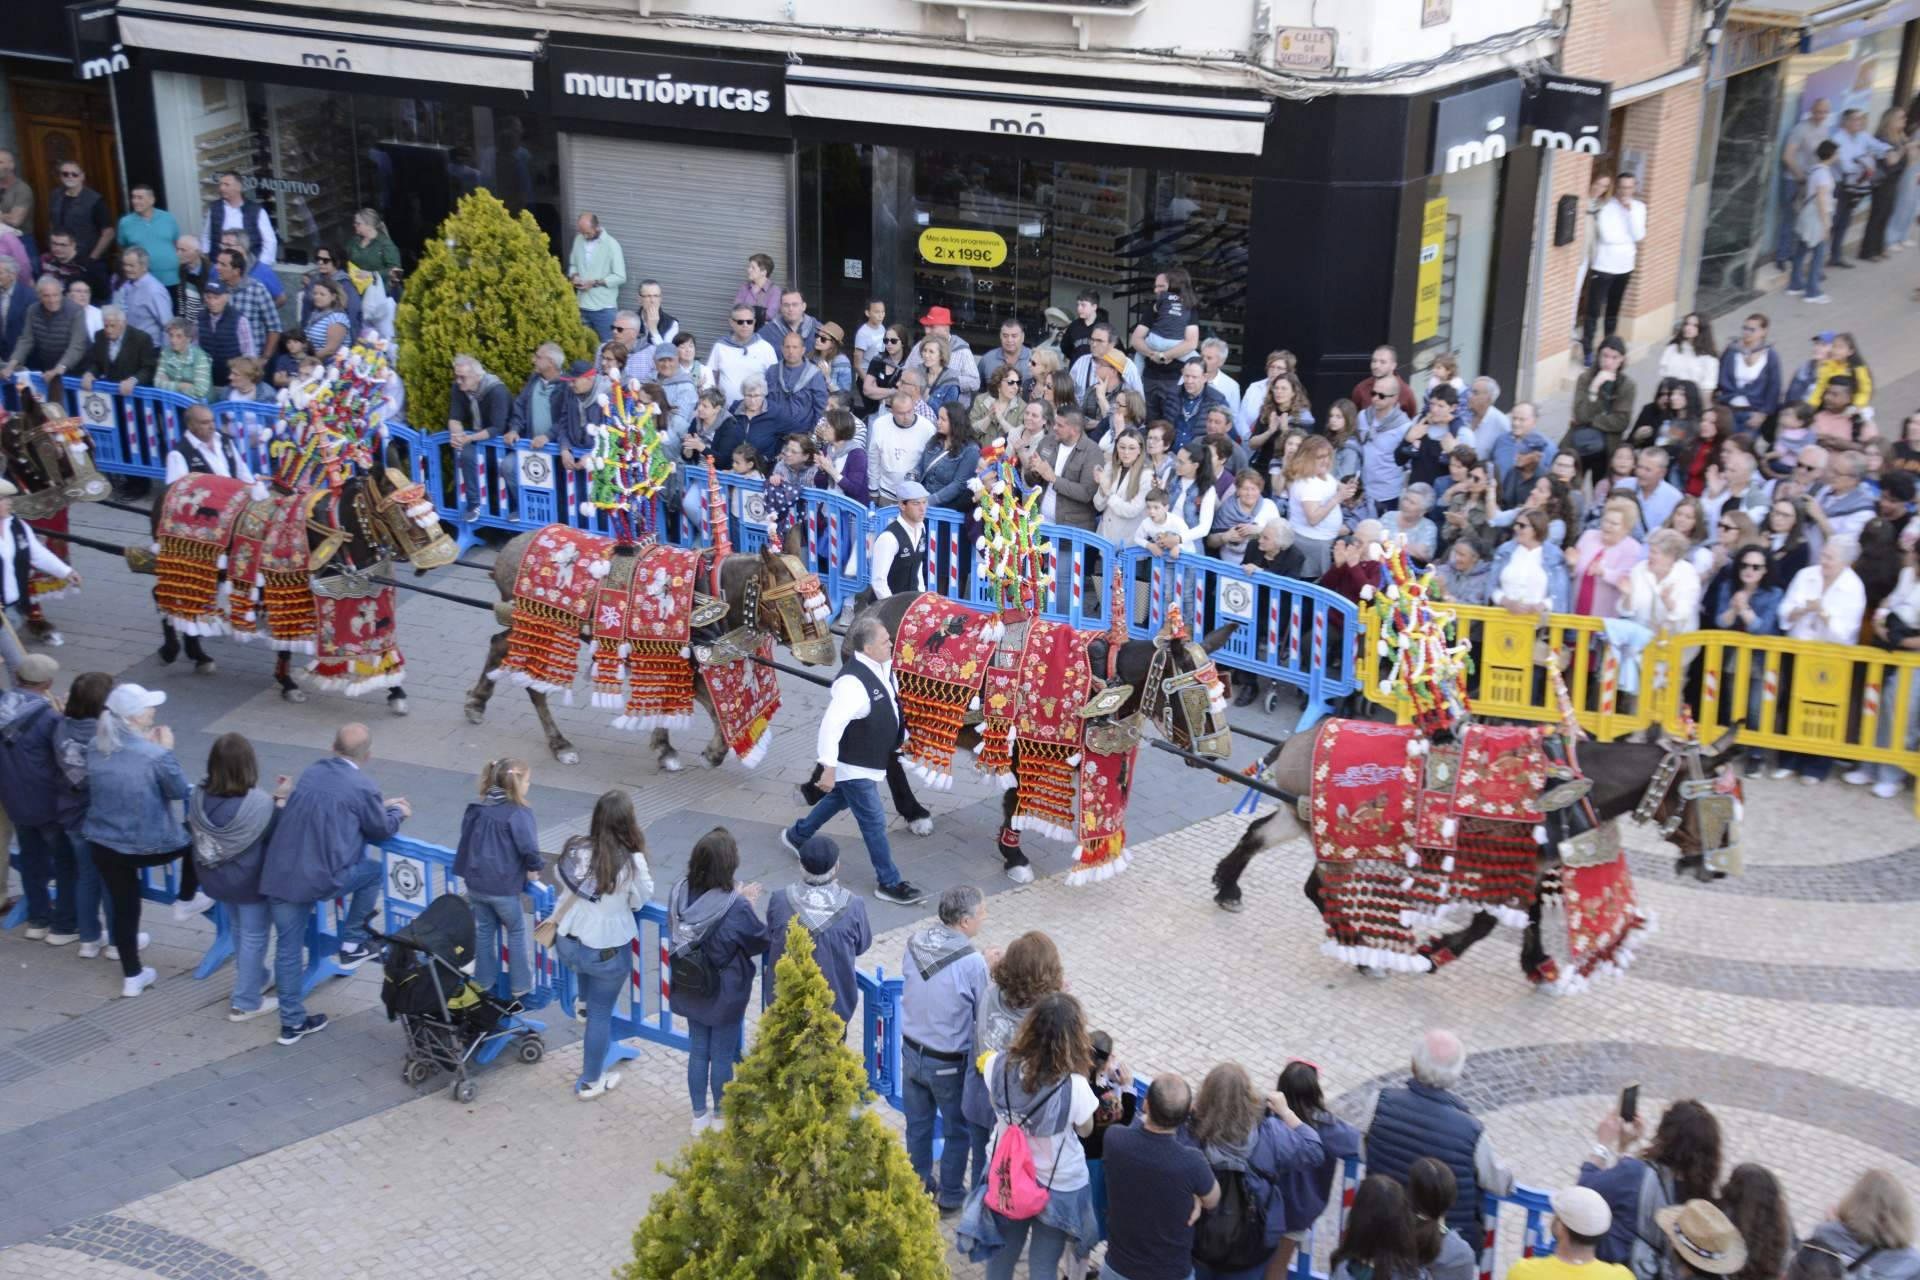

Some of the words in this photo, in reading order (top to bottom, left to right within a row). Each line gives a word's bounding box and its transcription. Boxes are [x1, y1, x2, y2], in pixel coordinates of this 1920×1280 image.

[1296, 32, 1325, 44] CALLE
[260, 178, 321, 195] AUDITIVO
[934, 246, 943, 258] 2
[948, 249, 955, 259] x
[958, 248, 992, 262] 199€
